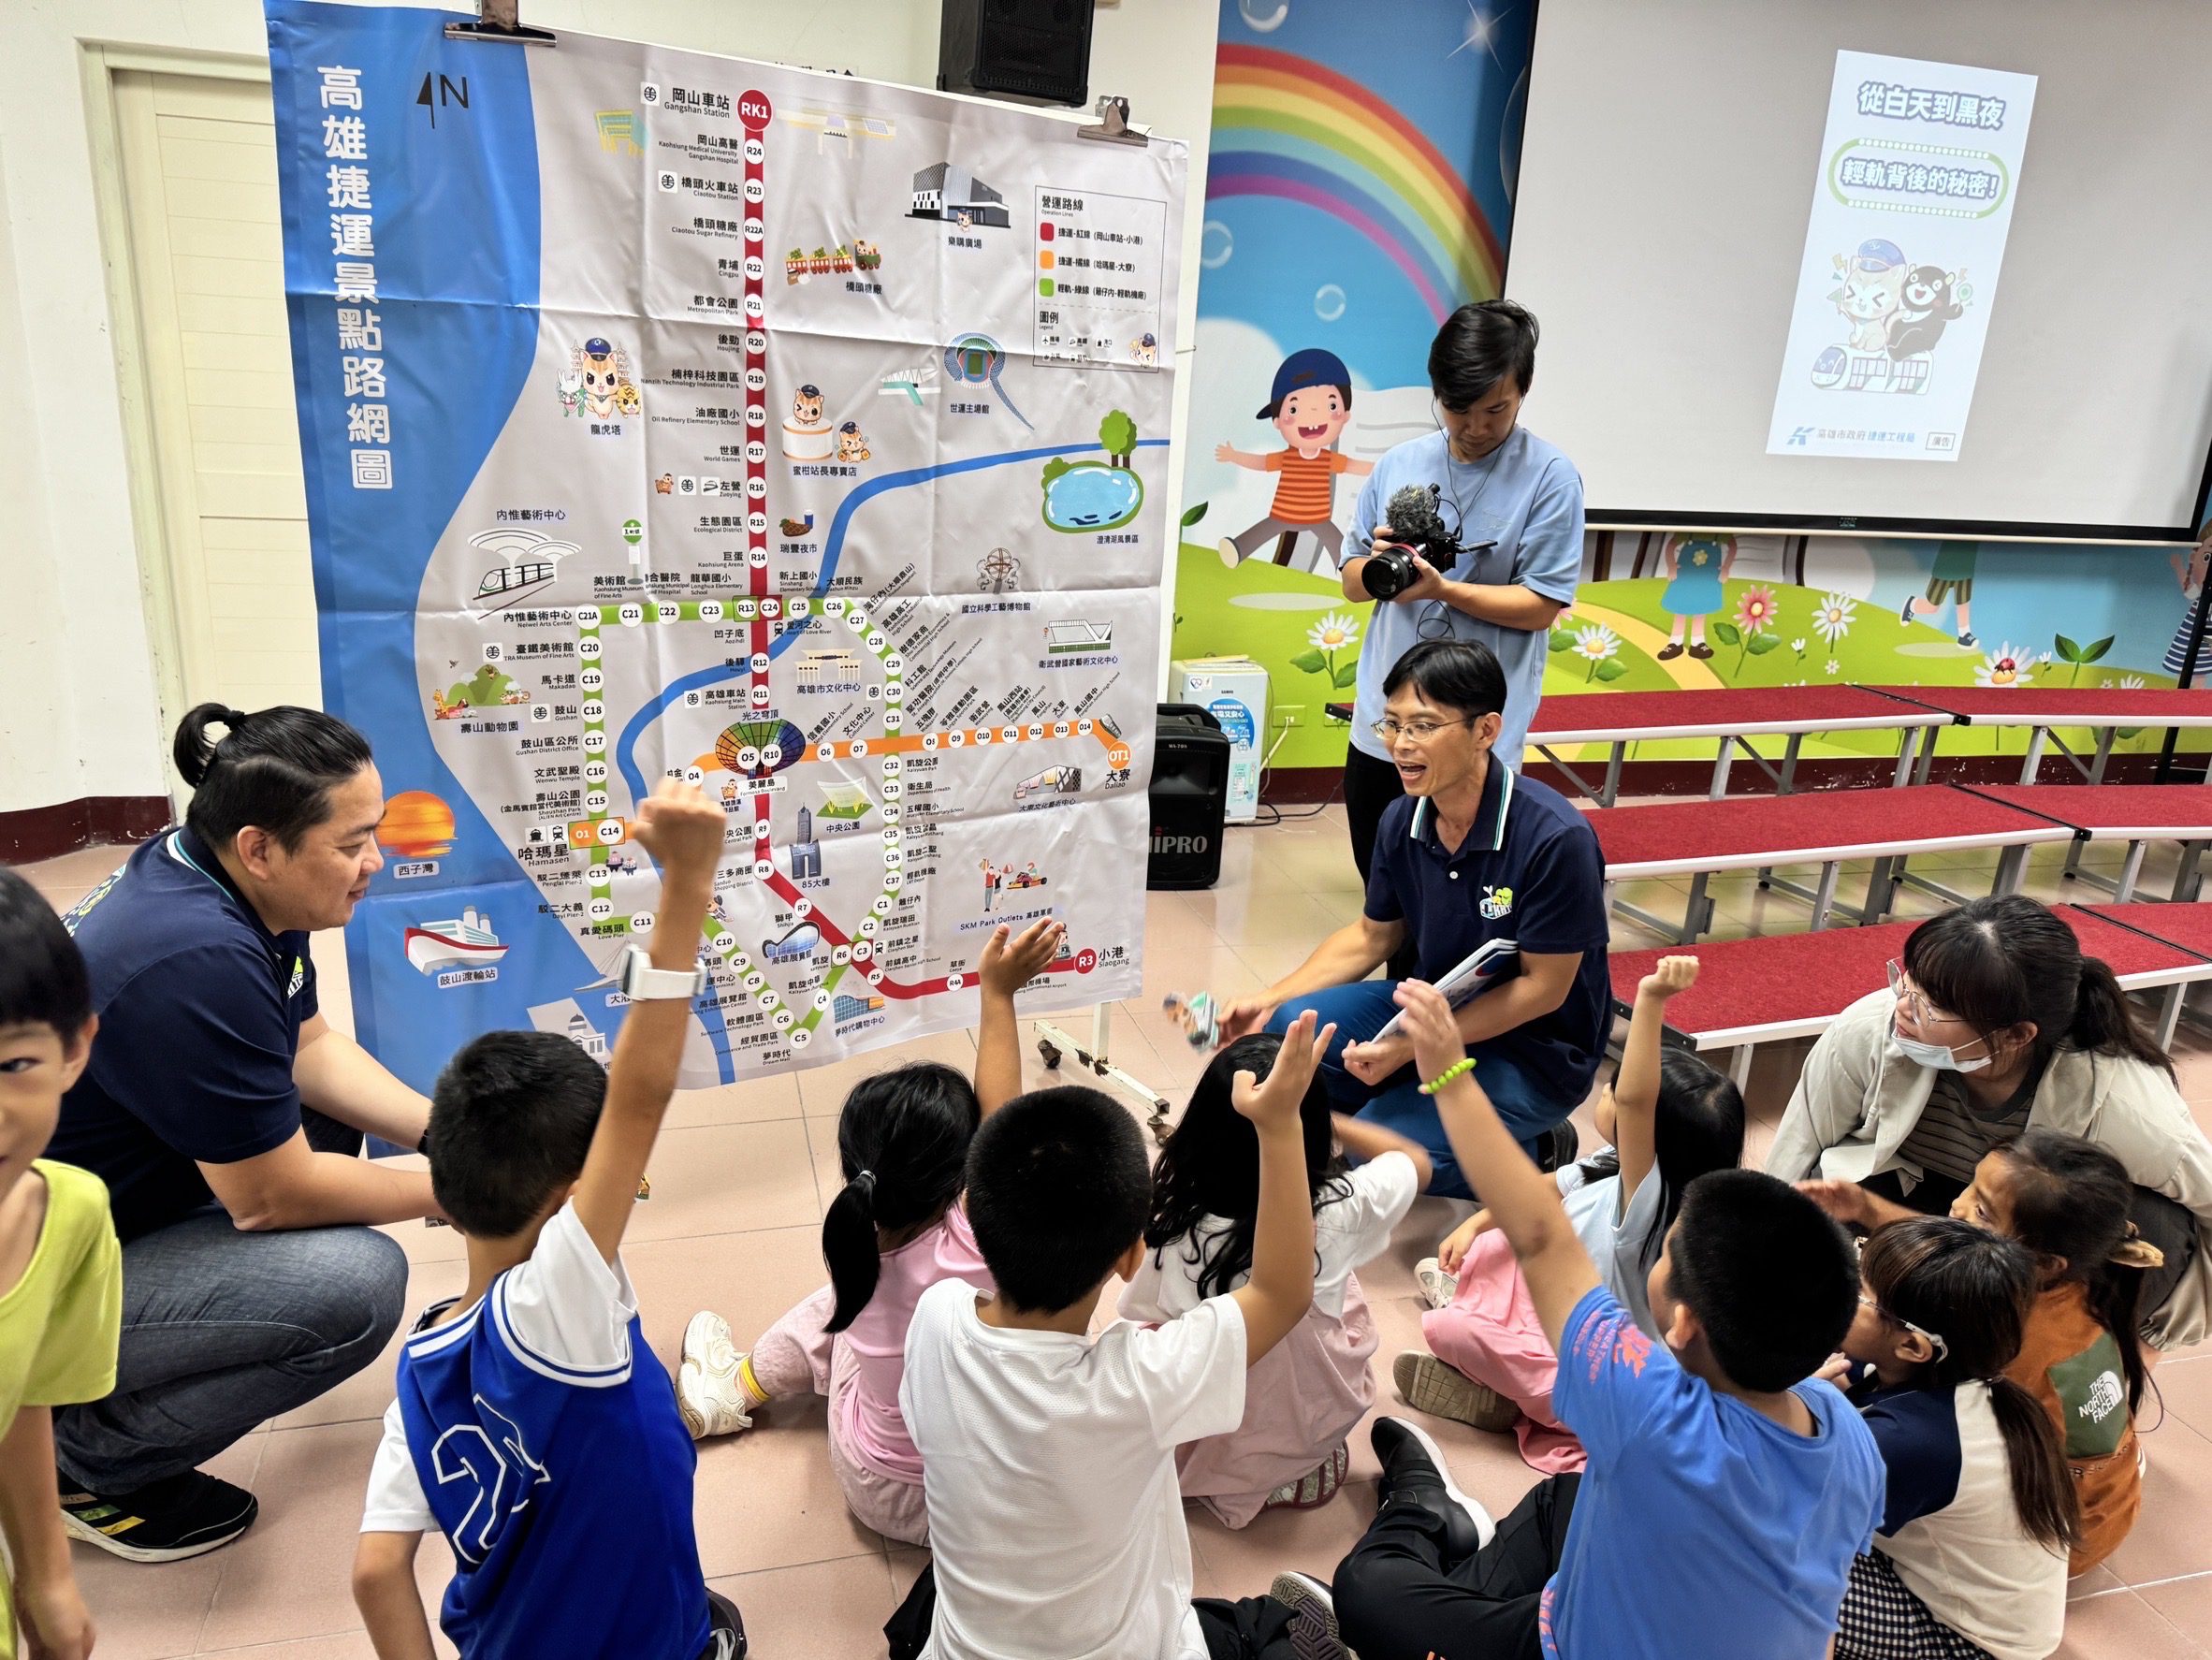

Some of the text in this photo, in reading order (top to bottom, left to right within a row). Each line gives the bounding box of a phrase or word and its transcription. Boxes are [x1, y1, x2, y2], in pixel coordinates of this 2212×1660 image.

[441, 77, 468, 109] N
[672, 87, 730, 110] 岡山車站
[664, 101, 730, 119] Gangshan Station
[741, 102, 768, 119] RK1
[1857, 80, 2006, 131] 從白天到黑夜
[697, 134, 738, 150] 岡山高醫
[747, 146, 762, 156] R24
[1841, 157, 2000, 200] 輕軌背後的秘密!
[681, 176, 738, 195] 橋頭火車站
[747, 186, 762, 196] R23
[718, 193, 738, 201] Station
[1041, 196, 1084, 211] 營運路線
[693, 216, 738, 232] 橋頭糖廠
[745, 226, 763, 235] R22A
[718, 258, 739, 271] 青埔
[747, 263, 762, 272] R22
[317, 65, 392, 488] 高雄捷運景點路網圖
[719, 270, 739, 279] Cingpu
[846, 281, 882, 296] 橋頭糖廠
[693, 295, 738, 310] 都會公園
[747, 300, 761, 311] R21
[1039, 311, 1059, 324] 圖例
[718, 333, 740, 345] 後勁
[748, 338, 764, 347] R20
[717, 345, 740, 354] Houjing
[671, 369, 739, 383] 楠梓科技園區
[748, 374, 764, 384] R19
[695, 407, 740, 419] 油廠國小
[950, 403, 990, 415] 世運主場館
[749, 411, 764, 420] R18
[590, 424, 621, 435] 龍虎塔
[1817, 429, 1866, 441] 高雄市政府
[720, 445, 740, 457] 世運
[749, 447, 764, 456] R17
[793, 466, 857, 477] 蜜柑站長專賣店
[720, 481, 741, 491] 左營
[749, 483, 764, 491] R16
[496, 509, 566, 521] 內惟藝術中心
[700, 517, 742, 527] 生態園區
[750, 518, 764, 527] R15
[723, 551, 744, 561] 巨蛋
[750, 553, 765, 561] R14
[593, 575, 626, 586] 美術館
[691, 573, 732, 583] 龍華國小
[779, 571, 818, 581] 新上國小
[826, 576, 863, 586] 大順民族
[659, 607, 677, 616] C22
[702, 606, 720, 615] C23
[738, 604, 755, 612] R13
[762, 604, 778, 612] C24
[792, 603, 807, 611] C25
[826, 603, 842, 611] C26
[962, 603, 1031, 614] 國立科學工藝博物館
[503, 610, 572, 623] 內惟藝術中心
[578, 611, 598, 620] C21A
[622, 609, 639, 619] C21
[881, 599, 912, 629] 高雄高工
[850, 617, 865, 625] C27
[714, 629, 745, 638] 凹子底
[869, 637, 883, 646] C28
[898, 624, 929, 655] 樹德家商
[516, 642, 575, 654] 臺鐵美術館
[580, 644, 599, 652] C20
[752, 659, 767, 667] R12
[886, 660, 901, 668] C29
[541, 674, 575, 685] 馬卡道
[582, 676, 601, 684] C19
[706, 689, 746, 699] 高雄車站
[753, 690, 767, 698] R11
[796, 683, 861, 694] 高雄市文化中心
[886, 688, 901, 696] C30
[555, 705, 577, 715] 鼓山
[584, 706, 602, 715] C18
[742, 709, 779, 721] 光之穹頂
[807, 711, 837, 741] 信義國小
[843, 706, 871, 736] 文化中心
[460, 721, 519, 734] 壽山動物園
[521, 735, 578, 749] 鼓山區公所
[585, 736, 604, 746] C17
[741, 752, 755, 762] O5
[764, 750, 779, 760] R10
[1108, 750, 1129, 763] OT1
[534, 765, 580, 779] 文武聖殿
[587, 767, 604, 776] C16
[688, 772, 700, 780] O4
[1106, 768, 1130, 783] 大寮
[749, 779, 776, 790] 美麗島
[1104, 780, 1126, 790] Daliao
[536, 790, 580, 803] 壽山公園
[588, 797, 605, 806] C15
[601, 827, 619, 836] C14
[826, 822, 860, 833] 中央公園
[518, 844, 569, 860] 哈瑪星
[528, 856, 570, 866] Hamasen
[398, 864, 434, 876] 西子灣
[589, 869, 607, 879] C13
[717, 866, 752, 880] 三多商圈
[758, 866, 769, 874] R8
[802, 878, 831, 889] 85大樓
[538, 902, 584, 914] 駁二大義
[591, 905, 610, 913] C12
[633, 918, 651, 926] C11
[775, 913, 793, 924] 獅甲
[960, 914, 1024, 931] SKM Park Outlets
[579, 924, 624, 937] 真愛碼頭
[863, 923, 874, 931] C2
[716, 938, 733, 946] C10
[837, 951, 847, 960] R6
[857, 947, 867, 955] C3
[1099, 946, 1124, 961] 小港
[733, 957, 747, 967] C9
[771, 953, 812, 966] 高雄展覽館
[1078, 955, 1094, 968] R3
[1099, 956, 1130, 969] Siaogang
[439, 969, 496, 986] 鼓山渡輪站
[748, 976, 760, 985] C8
[699, 993, 748, 1008] 高雄展覽館
[763, 996, 775, 1004] C7
[817, 995, 827, 1004] C4
[726, 1012, 764, 1027] 軟體園區
[777, 1015, 790, 1024] C6
[835, 1015, 885, 1038] 夢時代購物中心
[740, 1031, 779, 1045] 經貿園區
[794, 1034, 807, 1042] C5
[763, 1049, 791, 1061] 夢時代
[2088, 1376, 2105, 1394] THE
[2078, 1386, 2110, 1418] NORTH
[2091, 1396, 2113, 1424] FACE
